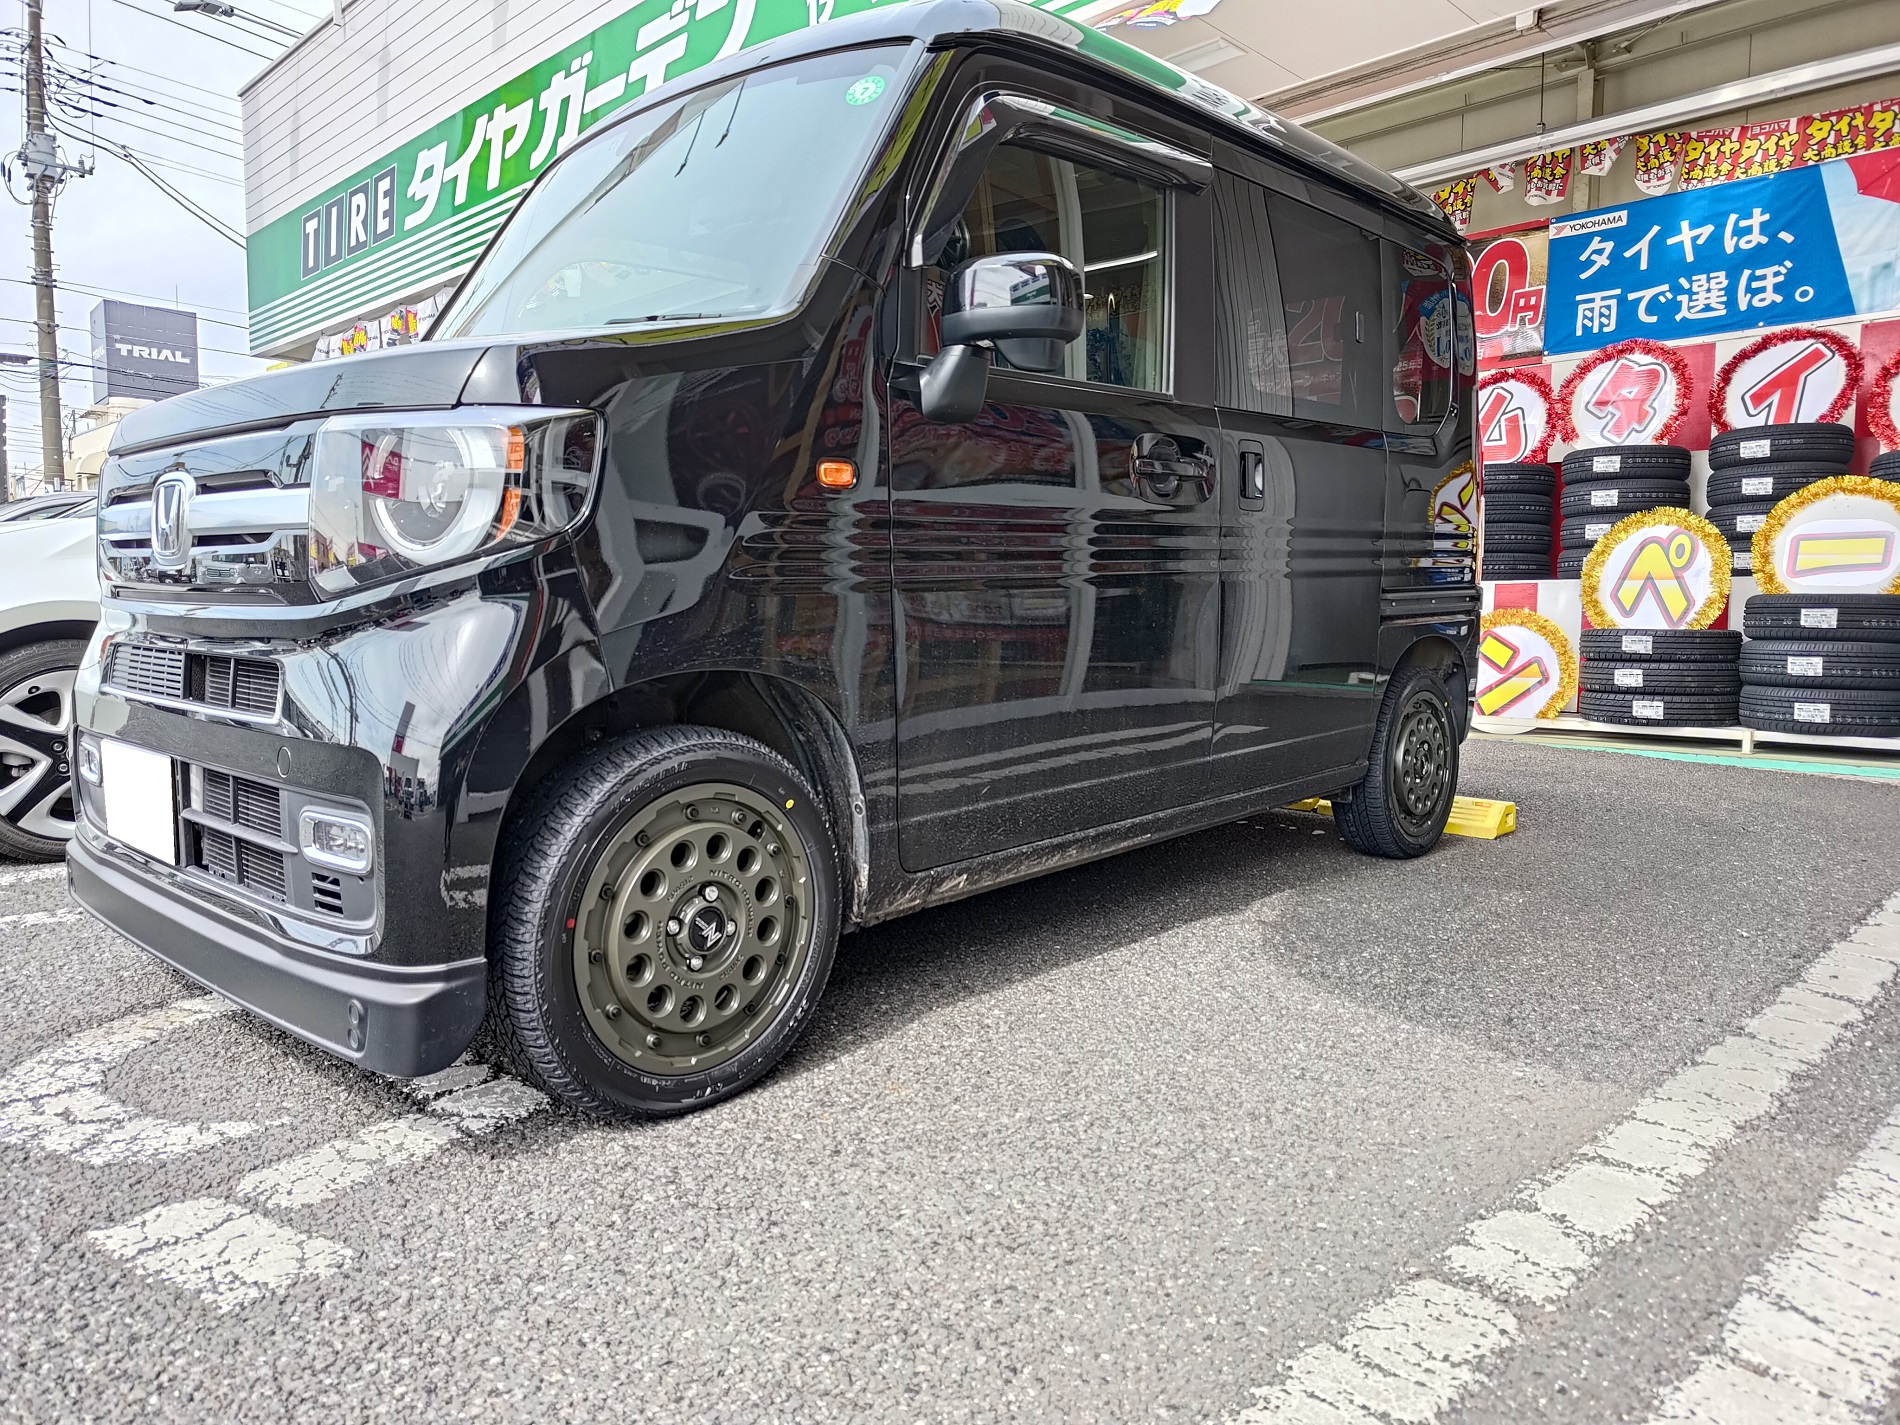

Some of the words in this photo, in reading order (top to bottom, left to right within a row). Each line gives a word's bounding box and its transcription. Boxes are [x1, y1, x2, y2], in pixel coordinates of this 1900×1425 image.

[1683, 137, 1742, 164] タイヤ
[1738, 131, 1800, 165] タイヤ
[1527, 165, 1568, 183] 商談会
[305, 176, 392, 269] TIRE
[1569, 214, 1624, 233] YOKOHAMA
[1578, 207, 1796, 280] タイヤは、
[1466, 237, 1546, 338] 0円
[1575, 259, 1815, 337] 雨で選ぼ。
[115, 342, 191, 364] TRIAL
